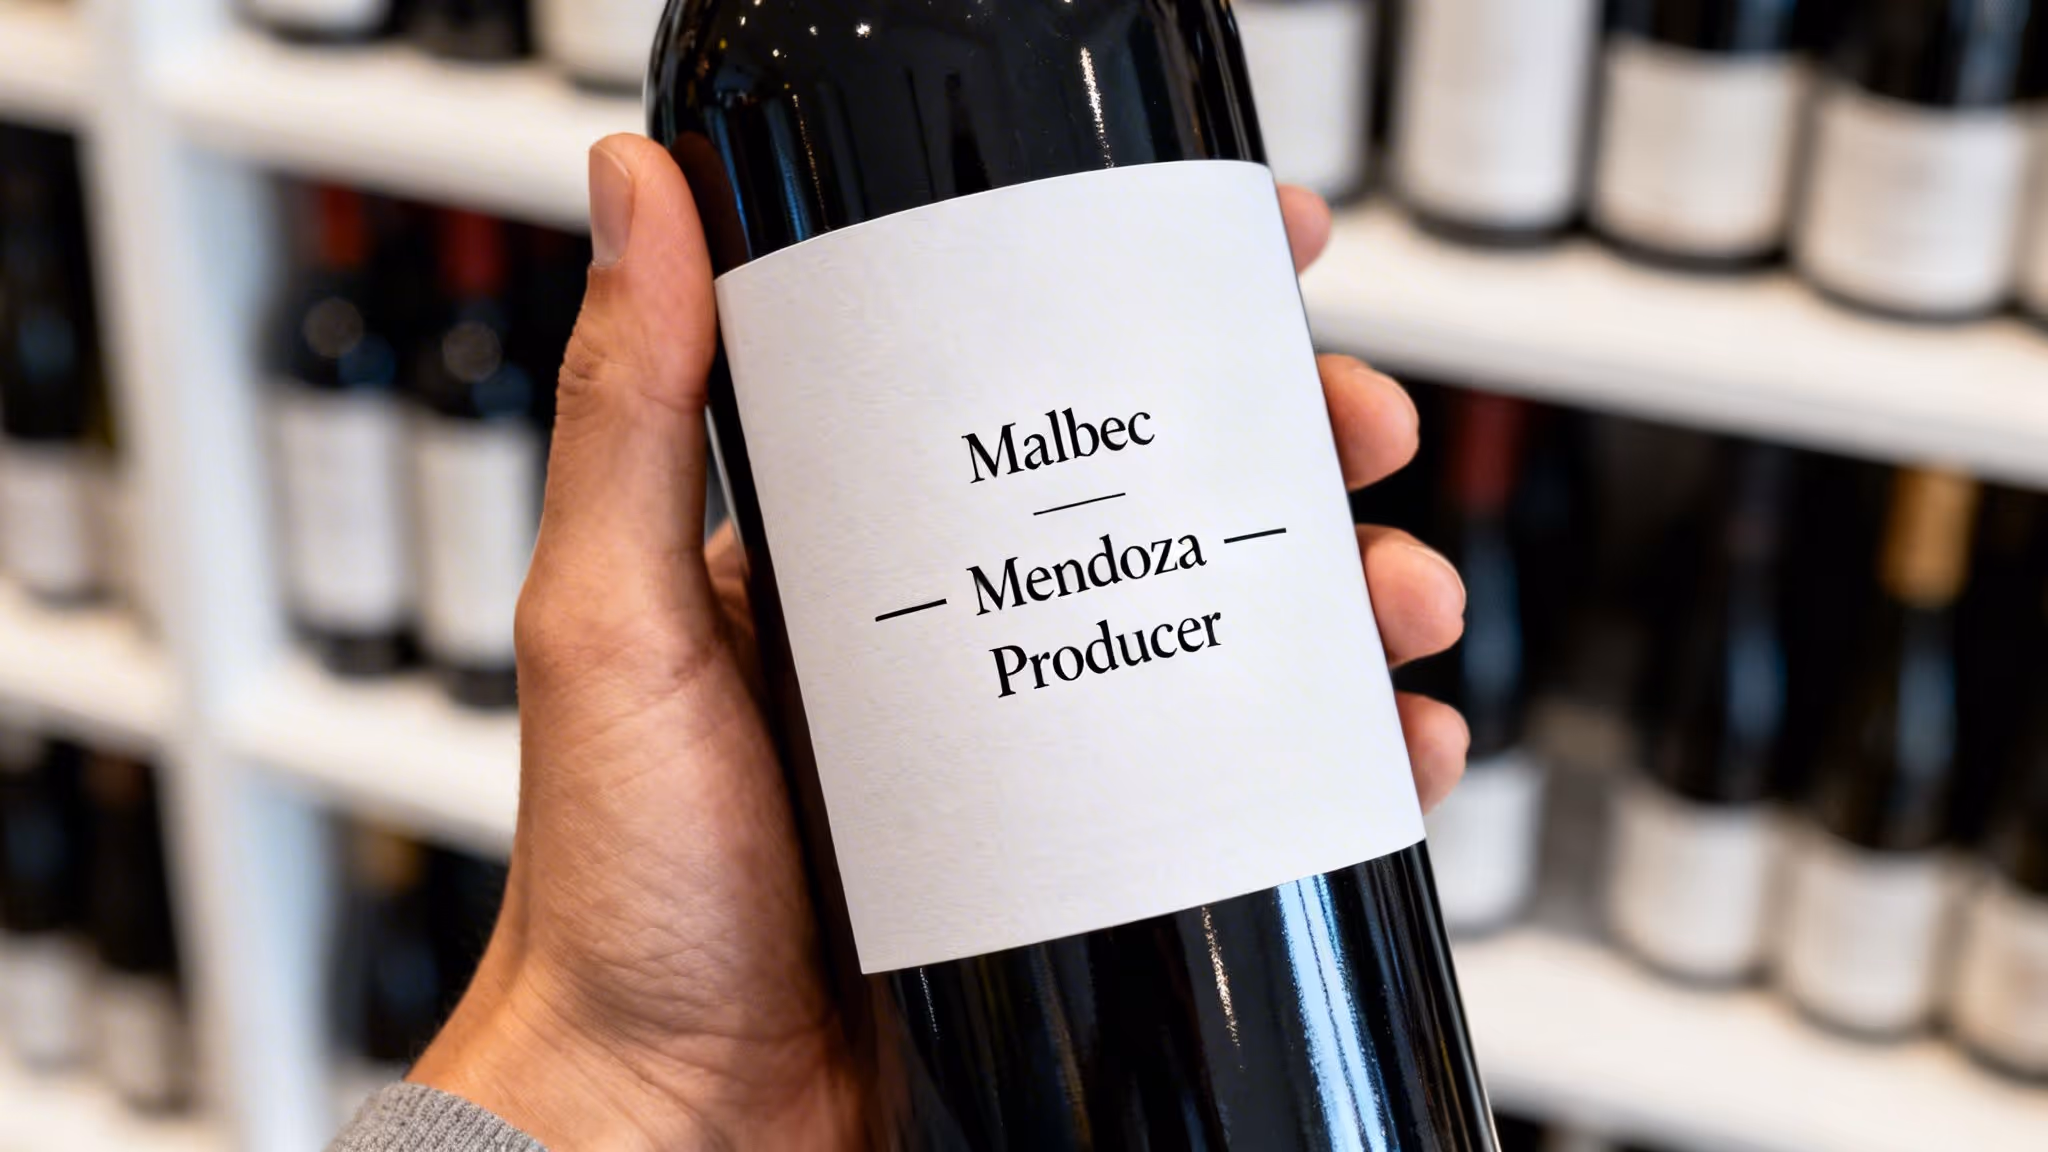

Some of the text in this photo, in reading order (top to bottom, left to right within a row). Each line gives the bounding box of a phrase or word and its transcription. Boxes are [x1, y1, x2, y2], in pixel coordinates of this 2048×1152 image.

[961, 407, 1156, 484] Malbec
[966, 533, 1208, 616] Mendoza
[988, 612, 1223, 699] Producer
